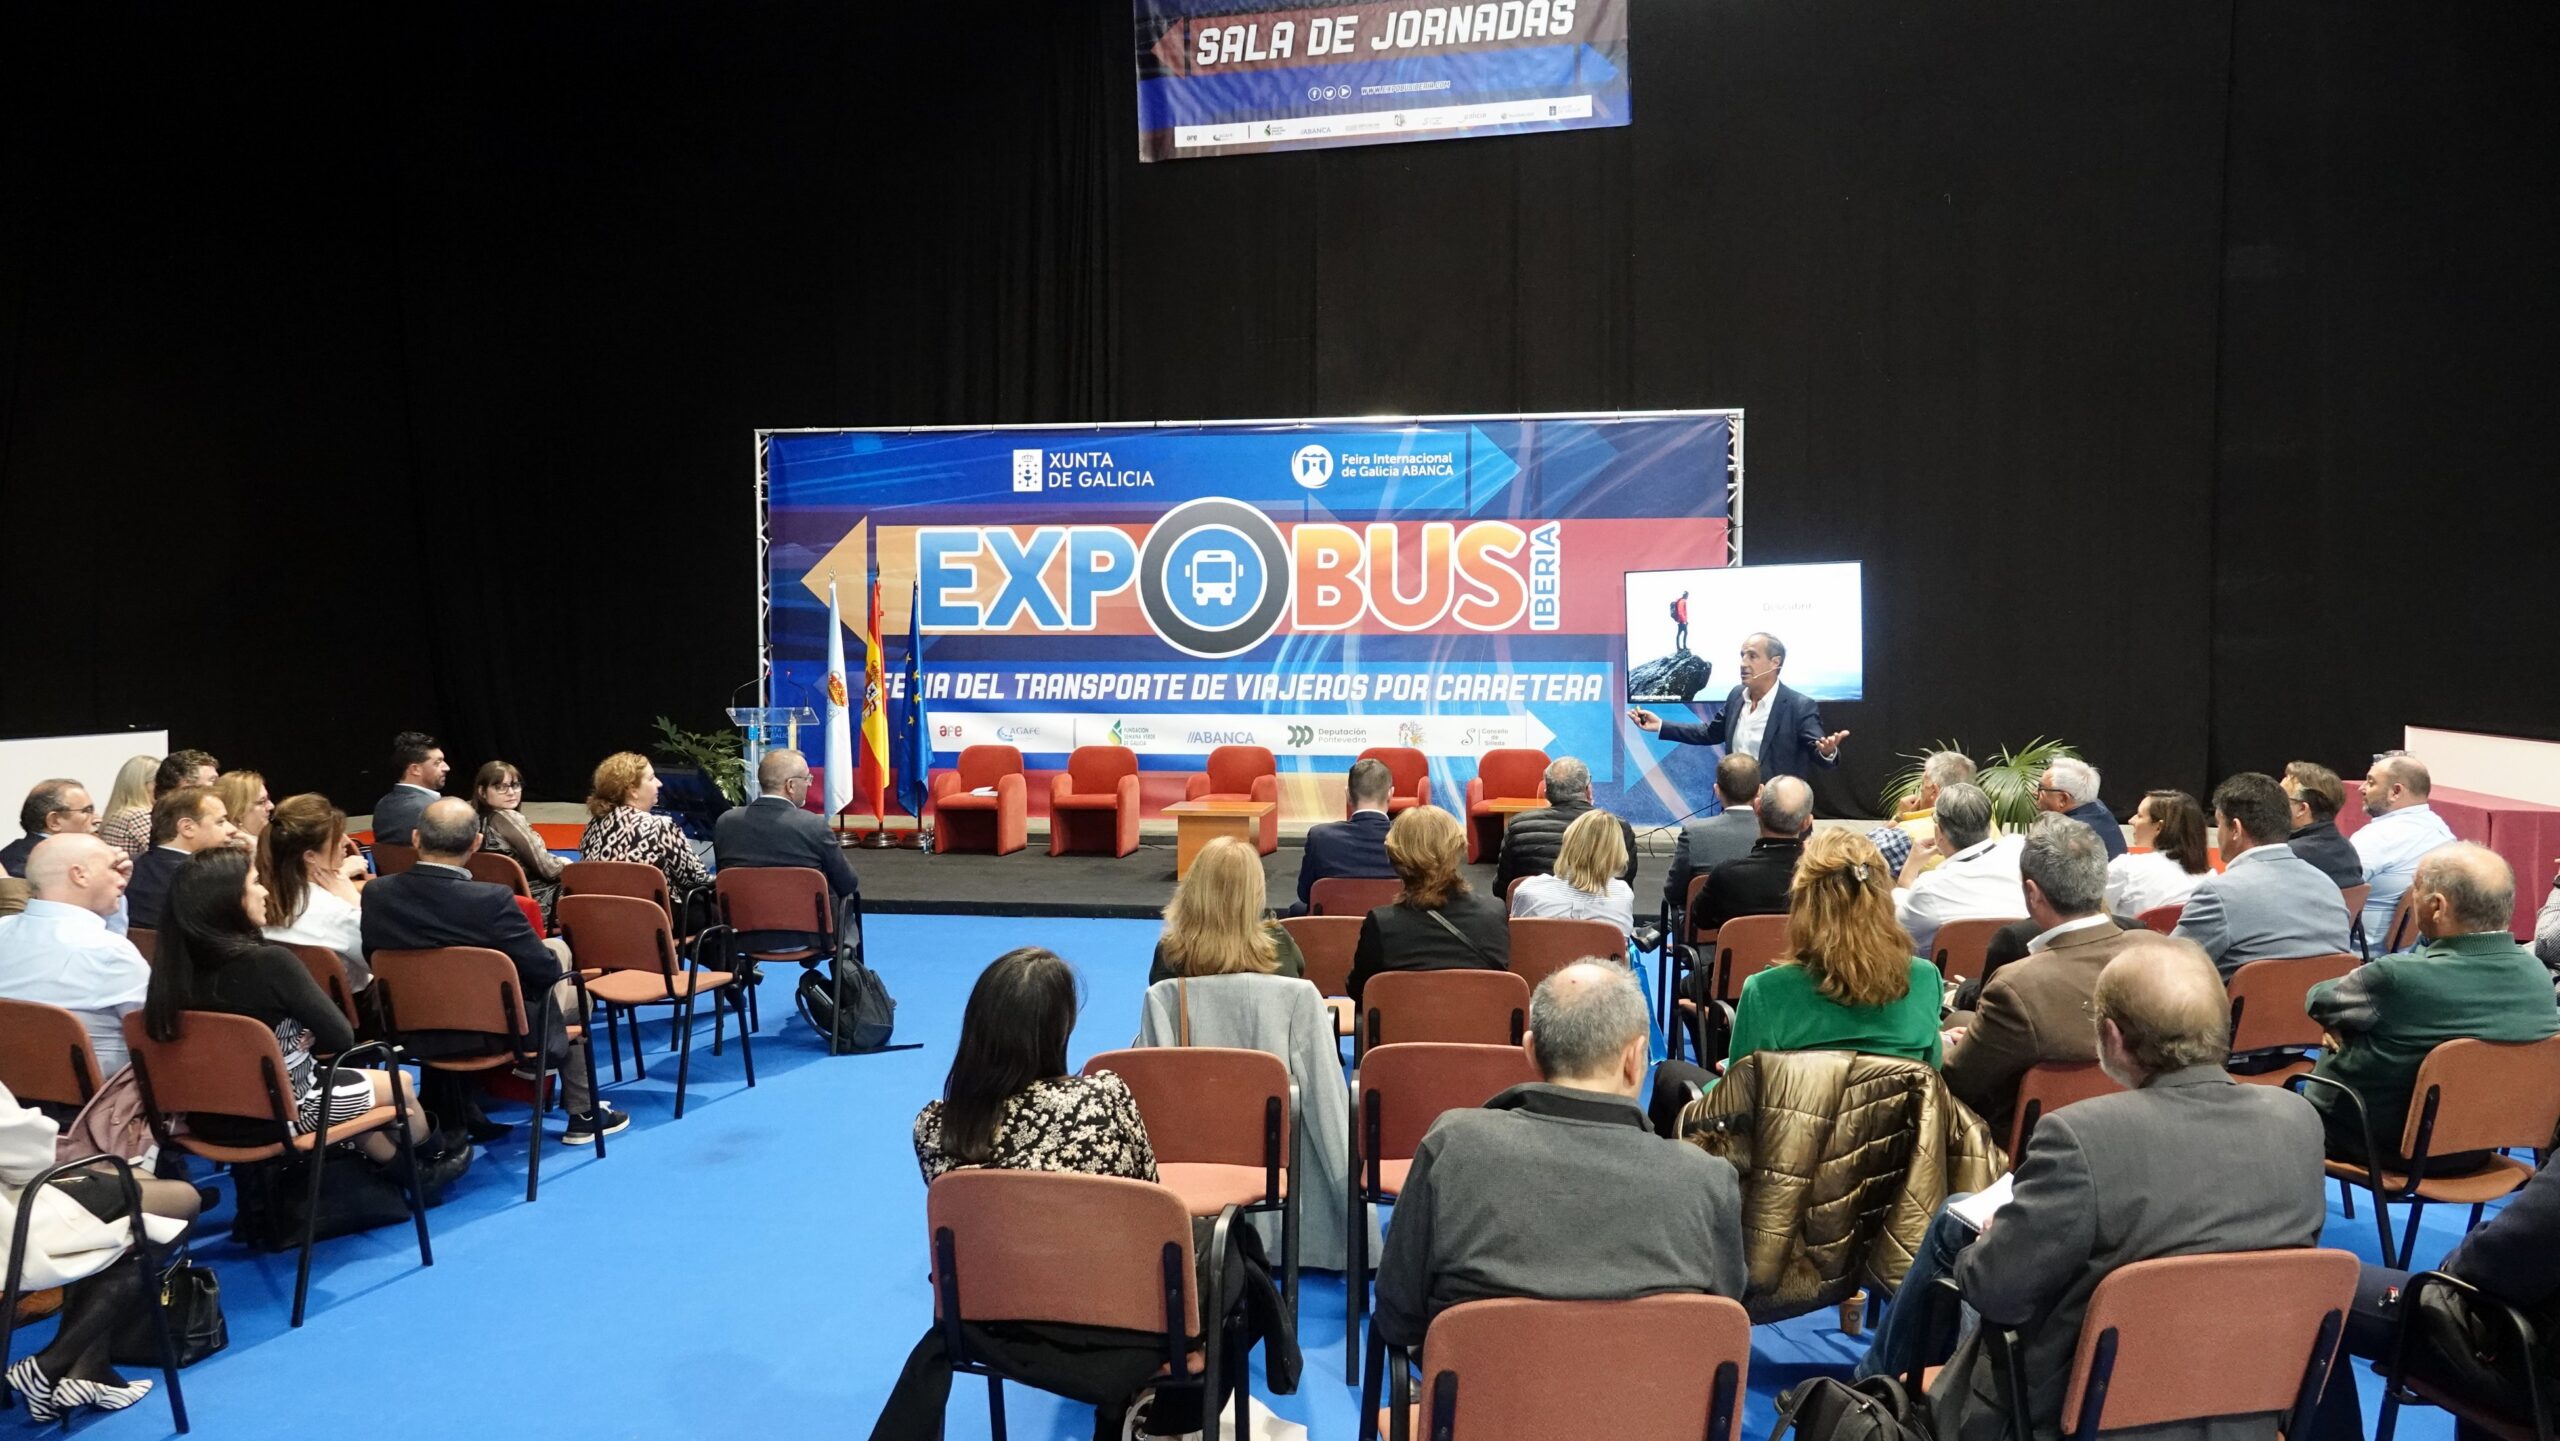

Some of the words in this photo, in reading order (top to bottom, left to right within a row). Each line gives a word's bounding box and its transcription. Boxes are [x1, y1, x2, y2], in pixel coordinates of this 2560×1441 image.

[1196, 21, 1295, 65] SALA
[1307, 15, 1359, 56] DE
[1371, 0, 1576, 50] JORNADAS
[1049, 452, 1114, 468] XUNTA
[1341, 454, 1370, 465] Feira
[1373, 452, 1453, 464] Internacional
[1341, 467, 1357, 477] de
[1360, 466, 1400, 477] Galicia
[1402, 465, 1454, 476] ABANCA
[1049, 472, 1072, 488] DE
[1078, 471, 1155, 487] GALICIA
[1532, 522, 1559, 628] IBERIA
[955, 672, 1005, 699] DEL
[1014, 673, 1187, 700] TRANSPORTE
[1191, 674, 1226, 700] DE
[1235, 674, 1369, 701] VIAJEROS
[1374, 674, 1430, 701] POR
[1435, 674, 1604, 701] CARRETERA
[1318, 728, 1367, 736] Deputación
